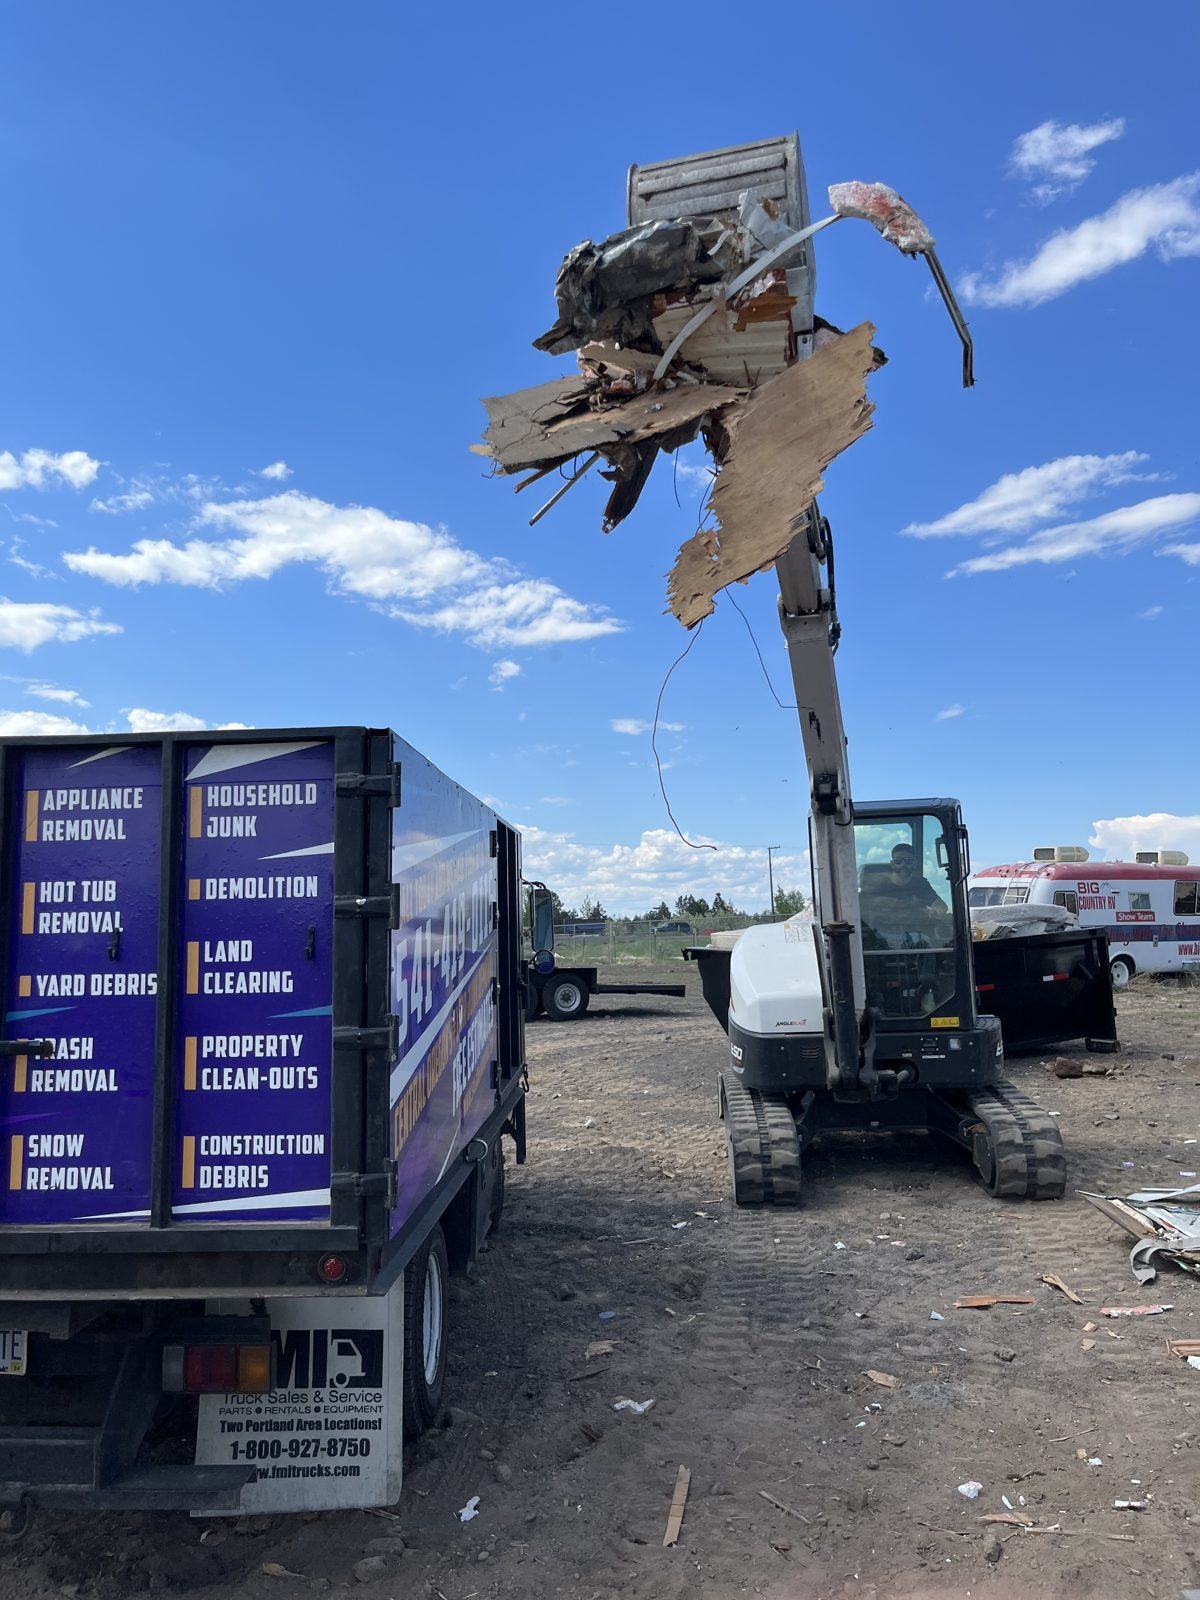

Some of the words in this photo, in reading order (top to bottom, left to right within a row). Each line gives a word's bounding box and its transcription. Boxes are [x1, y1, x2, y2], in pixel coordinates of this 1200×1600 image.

[43, 788, 144, 811] APPLIANCE
[207, 783, 318, 807] HOUSEHOLD
[42, 818, 126, 841] REMOVAL
[206, 816, 258, 838] JUNK
[40, 881, 75, 903] HOT
[81, 880, 117, 902] TUB
[205, 876, 318, 900] DEMOLITION
[1077, 882, 1100, 894] BIG
[1078, 896, 1106, 910] COUNTRY
[38, 912, 124, 934] REMOVAL
[1118, 912, 1136, 921] Show
[1136, 912, 1154, 921] Team
[204, 940, 253, 963] LAND
[37, 975, 85, 997] YARD
[90, 973, 158, 996] DEBRIS
[203, 971, 294, 994] CLEARING
[202, 1034, 303, 1058] PROPERTY
[31, 1069, 118, 1092] REMOVAL
[201, 1067, 318, 1091] CLEAN-OUTS
[394, 1062, 426, 1161] CENTRAL
[28, 1134, 85, 1157] SNOW
[200, 1134, 325, 1156] CONSTRUCTION
[26, 1167, 115, 1190] REMOVAL
[199, 1165, 269, 1188] DEBRIS
[223, 1391, 263, 1405] Truck
[267, 1390, 308, 1404] Sales
[313, 1390, 324, 1403] &
[329, 1389, 382, 1403] Service
[219, 1406, 253, 1416] PARTS
[264, 1405, 312, 1415] RENTALS
[323, 1405, 384, 1414] EQUIPMENT
[219, 1419, 243, 1433] Two
[245, 1418, 294, 1433] Portland
[296, 1418, 322, 1431] Area
[324, 1417, 382, 1431] Locations!
[230, 1437, 371, 1460] 1-800-927-8750
